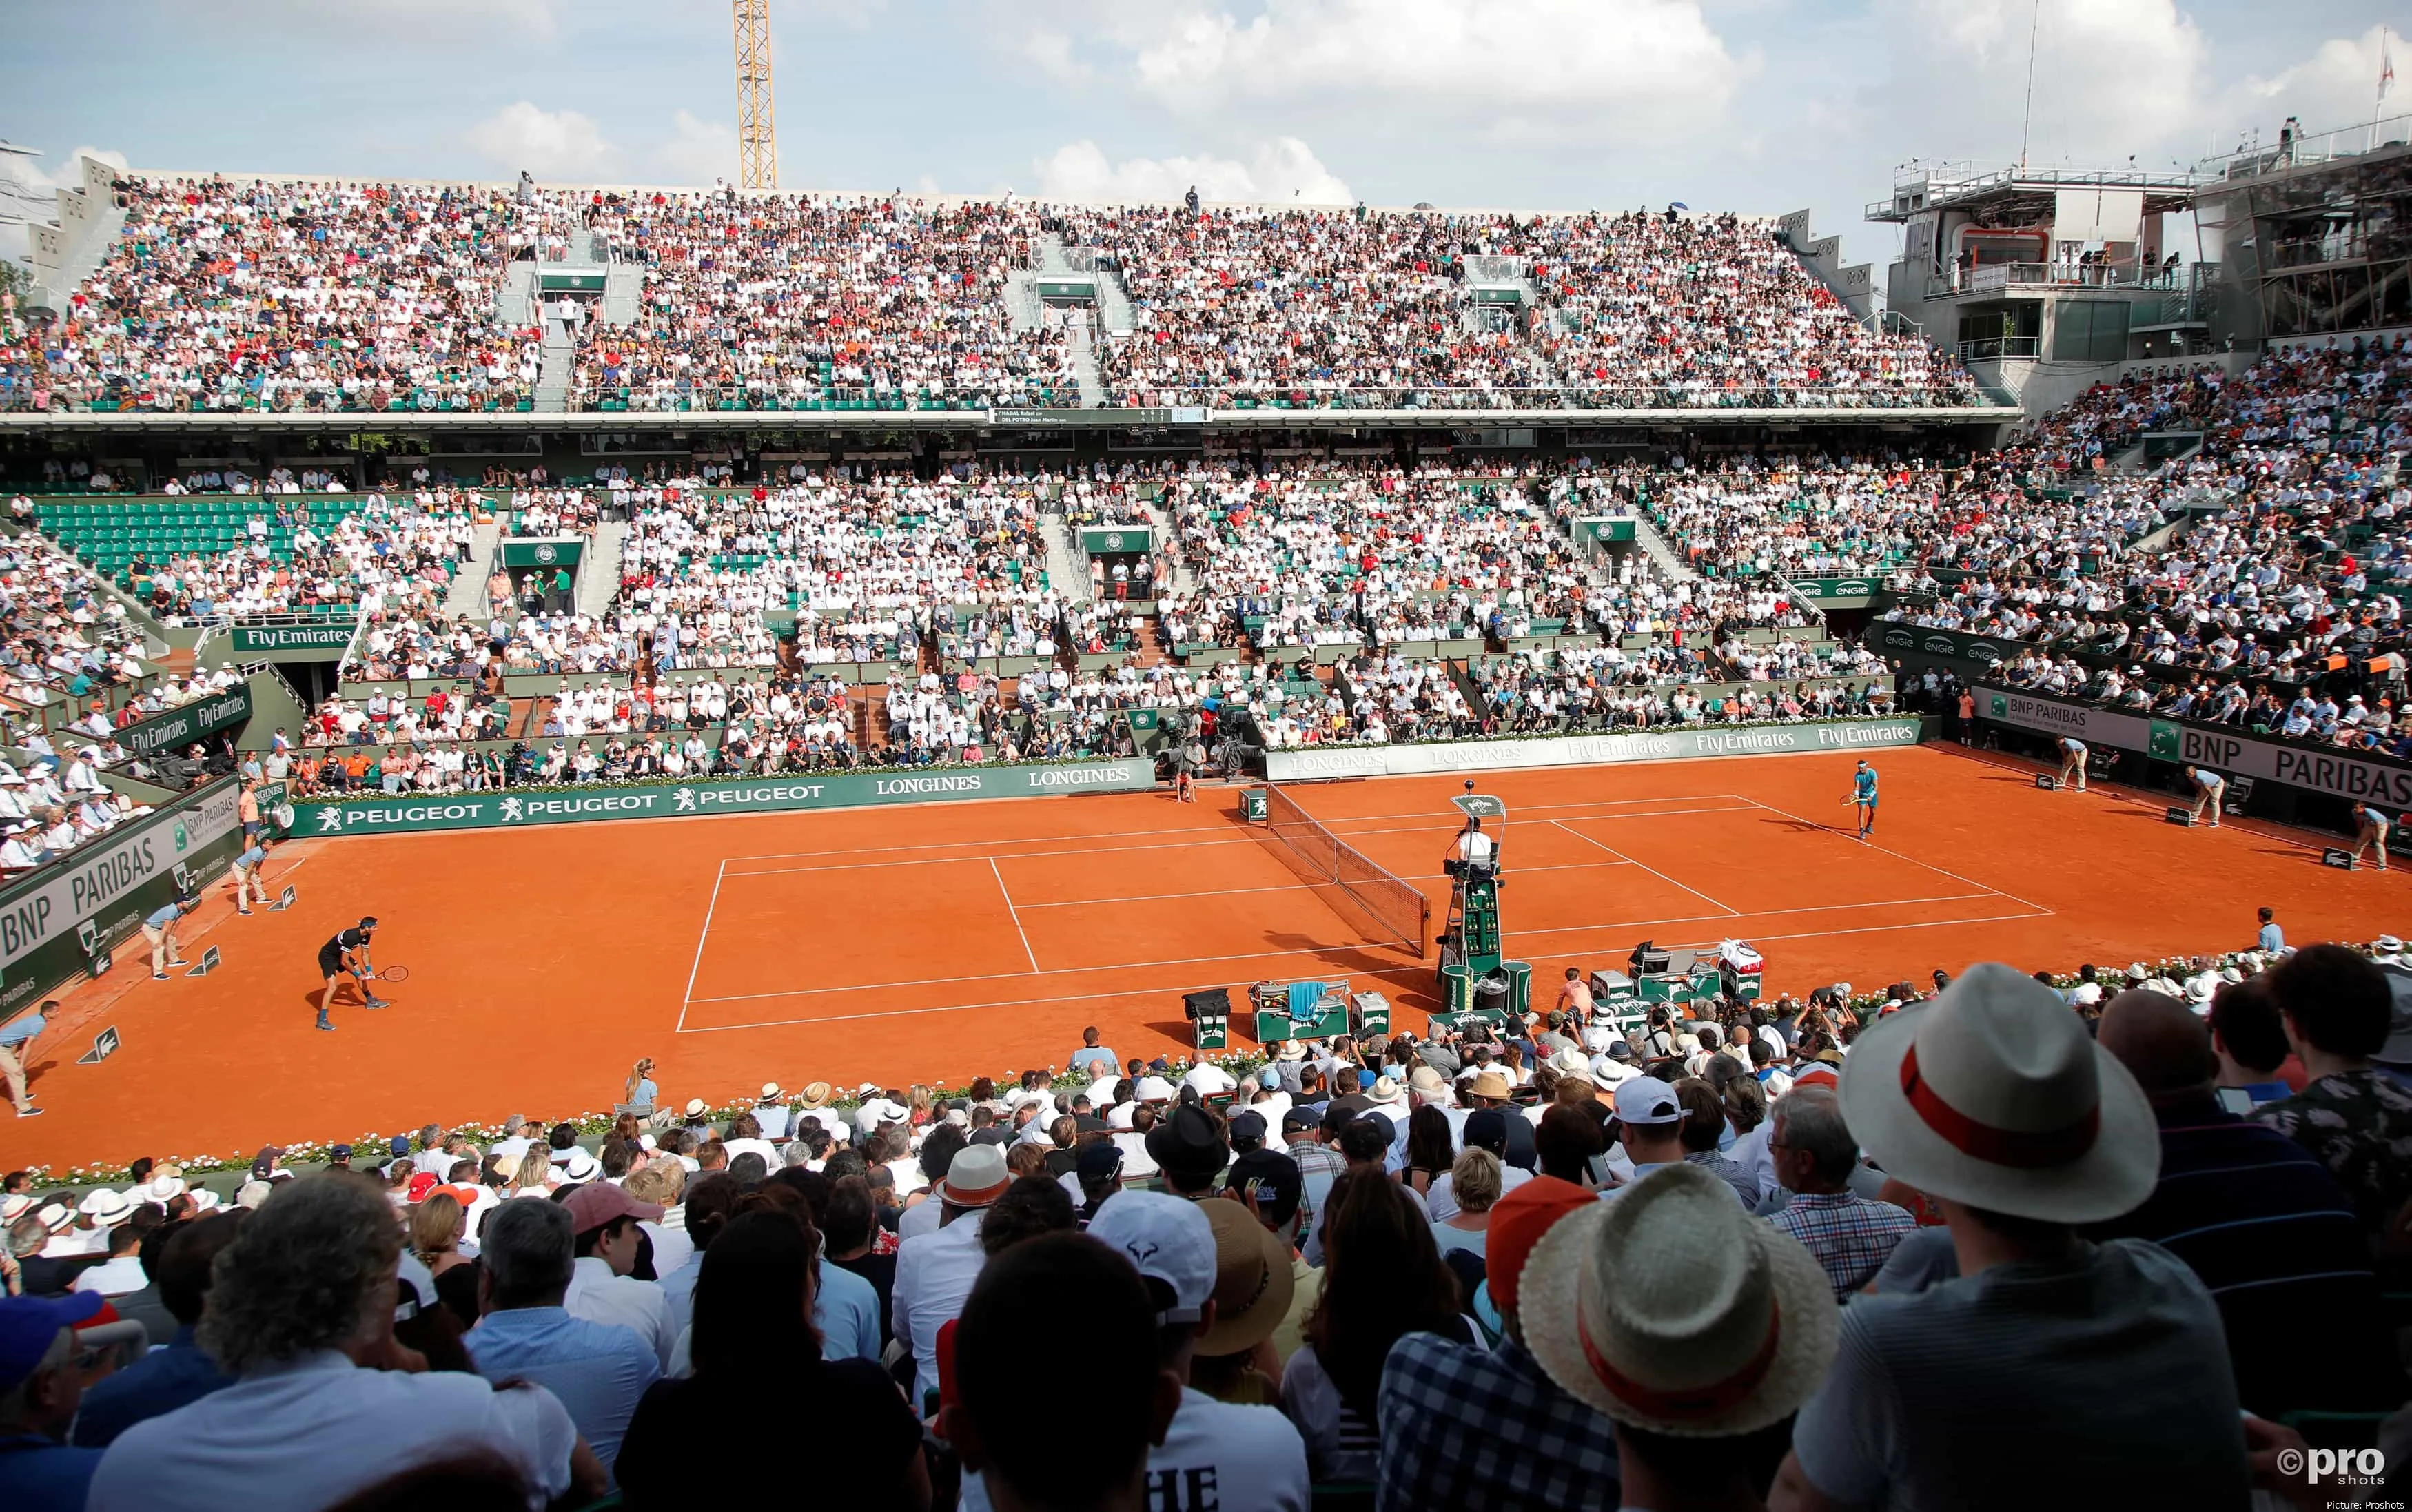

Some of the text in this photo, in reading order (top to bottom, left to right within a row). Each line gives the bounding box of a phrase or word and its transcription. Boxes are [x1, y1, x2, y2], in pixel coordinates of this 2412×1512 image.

[247, 629, 351, 647] Fly Emirates
[198, 695, 245, 728] Fly Emirates
[2010, 699, 2086, 726] BNP PARIBAS
[148, 718, 187, 748] Emirates
[1695, 731, 1795, 753] Fly Emirates
[1818, 724, 1914, 747] Fly Emirates
[1432, 746, 1522, 766] LONGINES
[1568, 736, 1671, 760] Fly Emirates
[1291, 754, 1387, 773] LONGINES
[2184, 732, 2412, 805] BNP PARIBAS
[876, 775, 981, 795] LONGINES
[1029, 767, 1131, 786] LONGINES
[254, 784, 283, 799] NGINES
[700, 785, 824, 804] PEUGEOT
[188, 813, 205, 835] BNP
[204, 797, 234, 823] PARIBAS
[347, 804, 484, 824] PEUGEOT
[527, 795, 658, 815] PEUGEOT
[1, 837, 155, 957] BNP PARIBAS
[114, 910, 140, 934] PARIBAS
